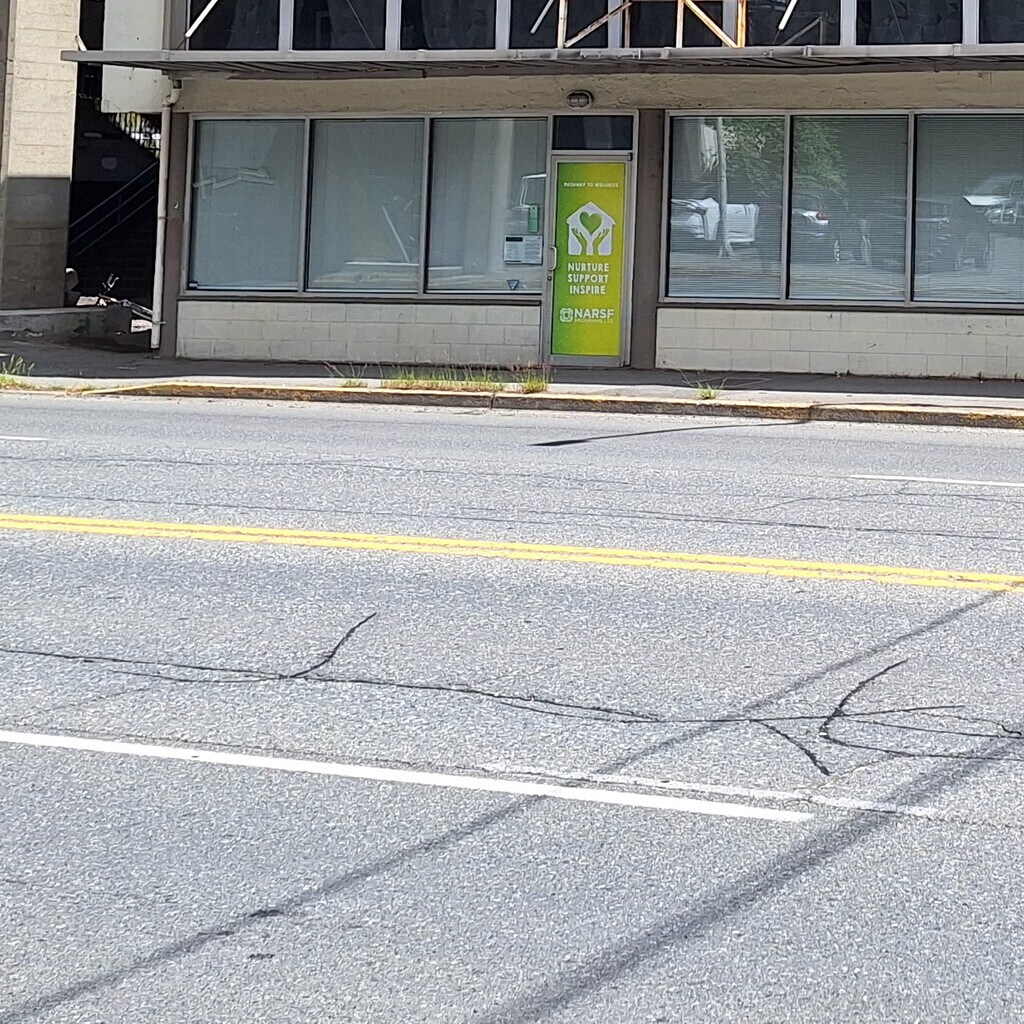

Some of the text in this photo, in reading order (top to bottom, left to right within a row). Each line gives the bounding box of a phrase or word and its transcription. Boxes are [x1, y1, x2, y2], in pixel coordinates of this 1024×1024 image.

[567, 262, 610, 272] NURTURE
[567, 274, 609, 284] SUPPORT
[569, 285, 606, 295] INSPIRE
[574, 308, 615, 319] NARSF
